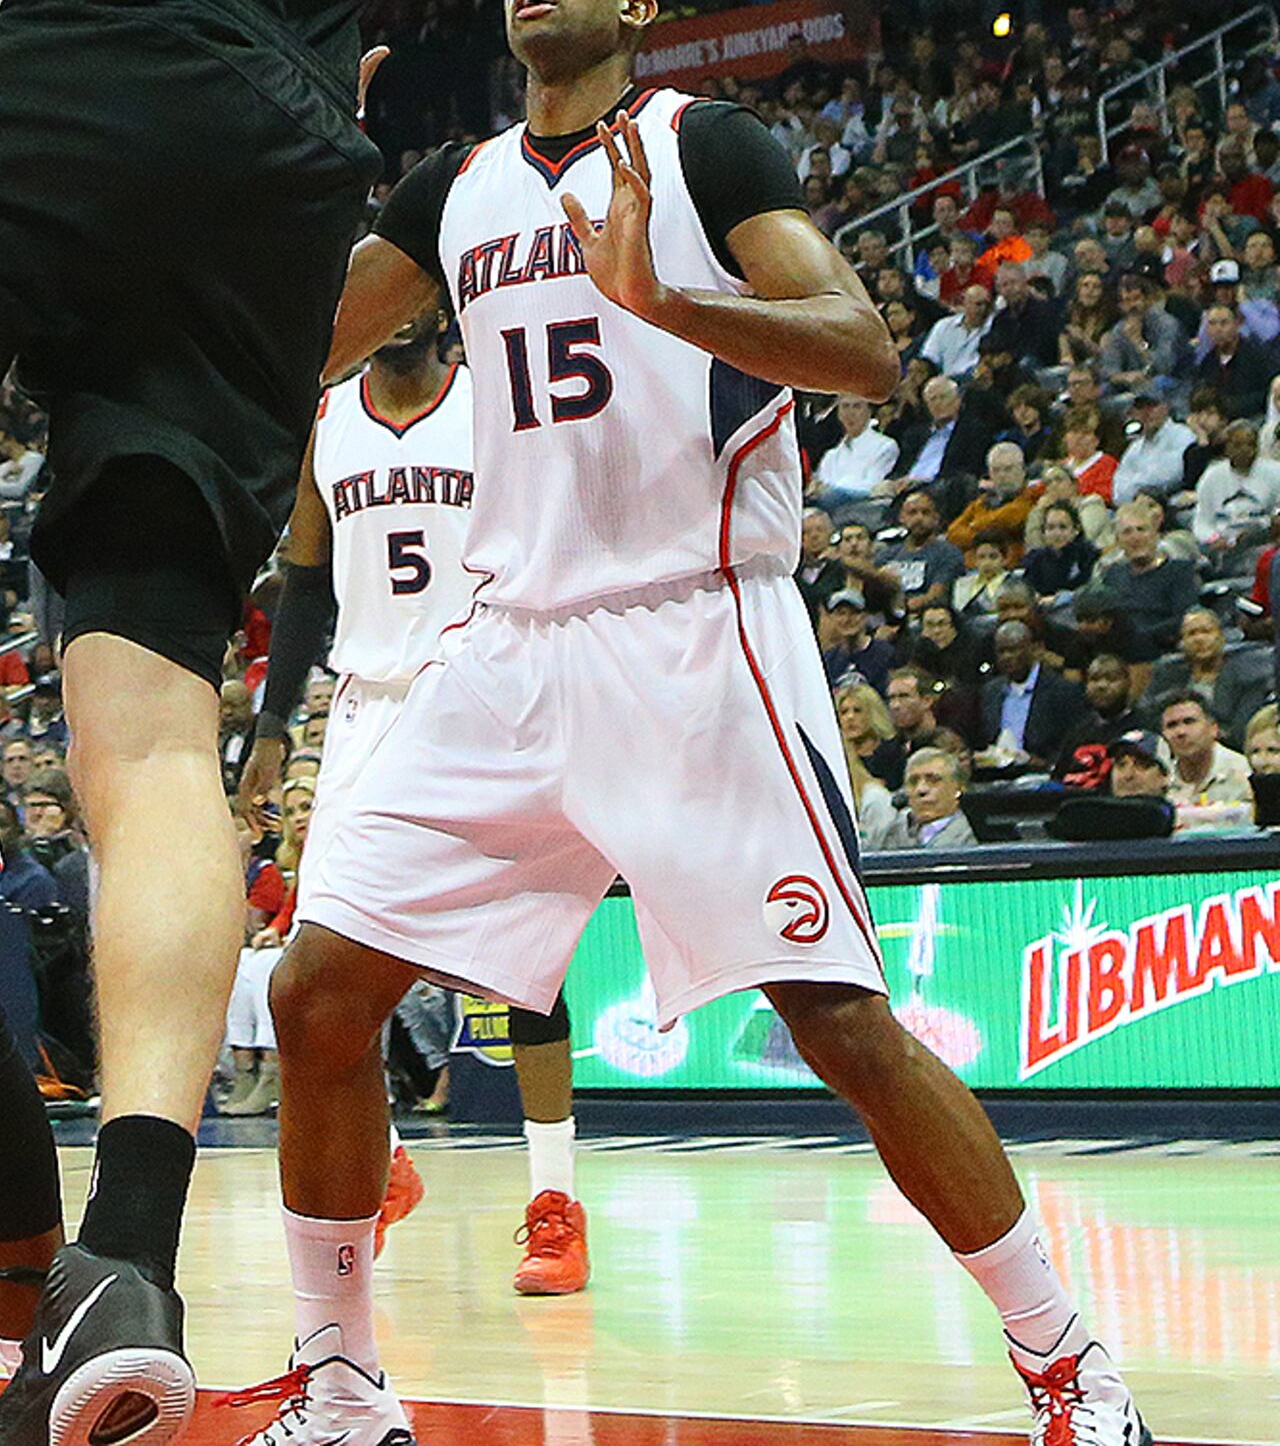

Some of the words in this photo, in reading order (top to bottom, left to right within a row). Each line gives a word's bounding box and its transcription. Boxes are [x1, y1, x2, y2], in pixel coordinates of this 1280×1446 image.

[458, 221, 592, 315] ATLAN
[500, 316, 614, 432] 15
[332, 466, 474, 523] ATLANTA
[388, 529, 432, 596] 5
[1018, 881, 1280, 1083] LIBMAN
